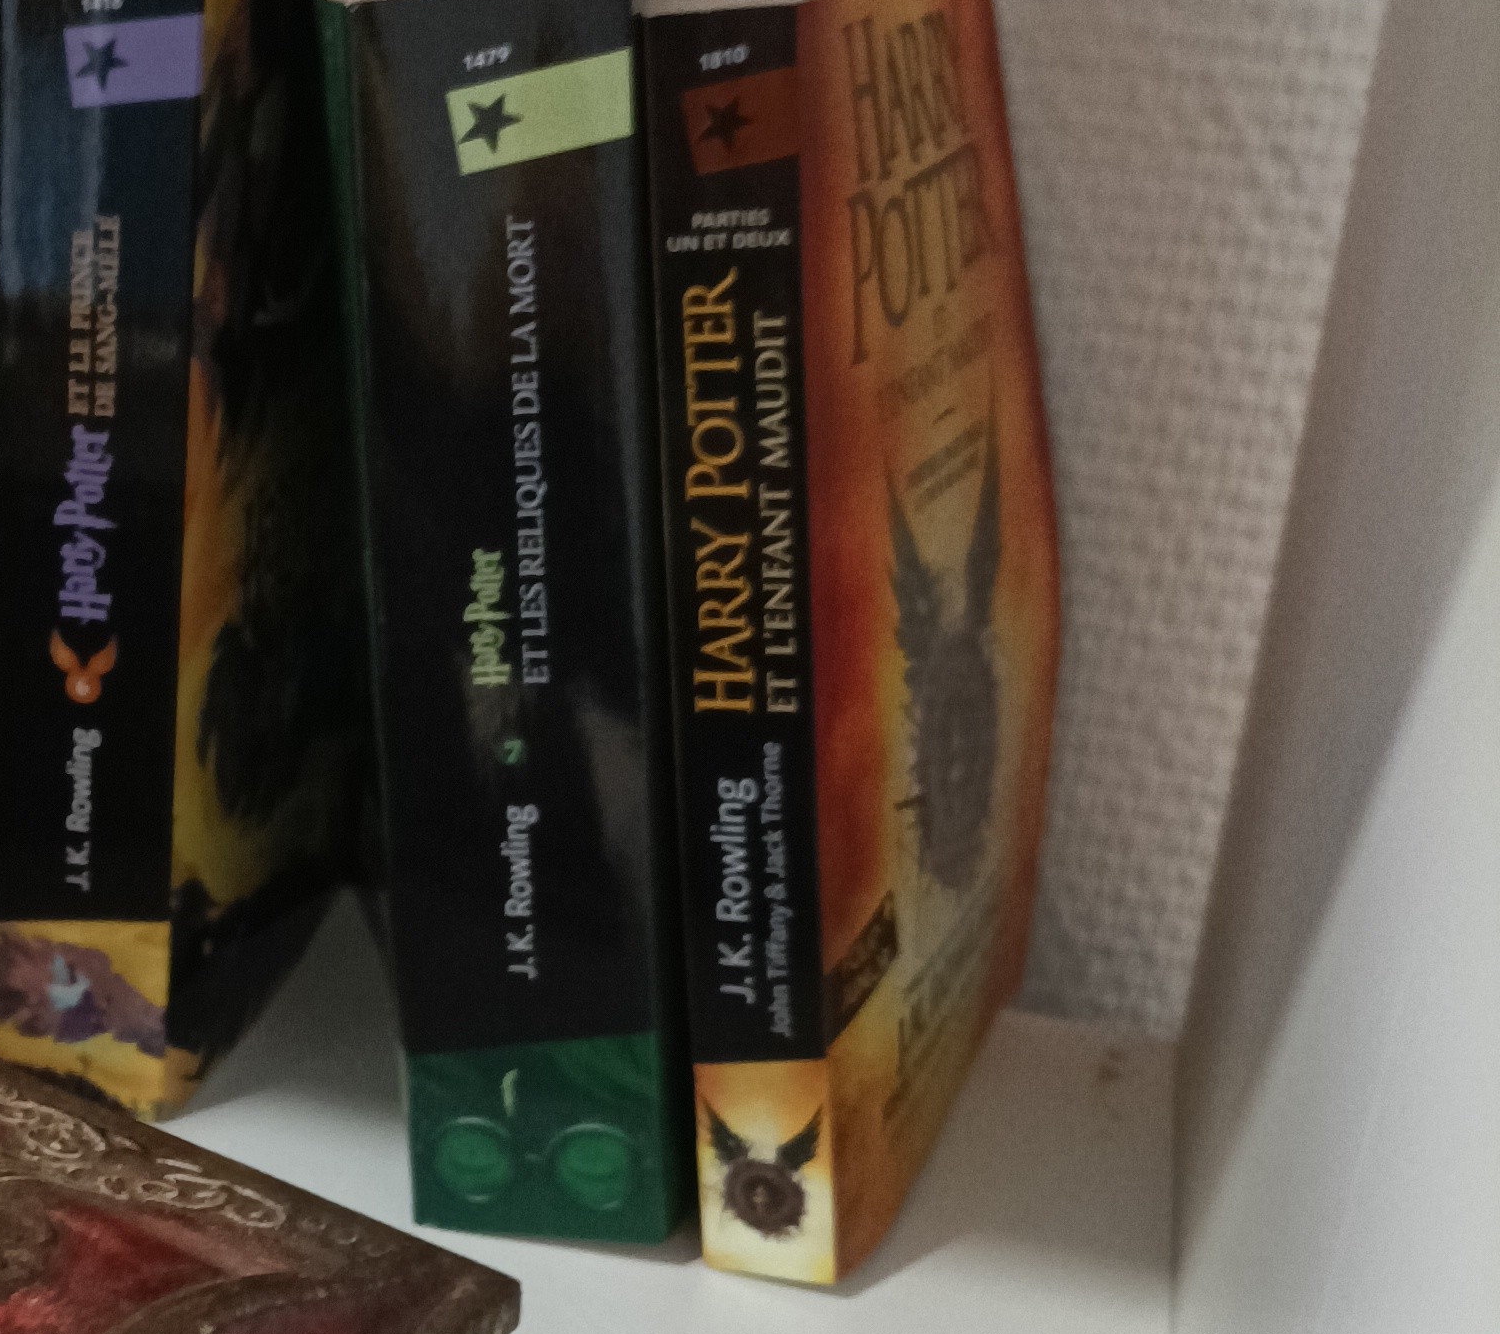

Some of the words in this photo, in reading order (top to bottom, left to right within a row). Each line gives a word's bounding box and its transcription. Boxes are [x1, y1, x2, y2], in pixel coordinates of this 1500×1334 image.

[463, 42, 513, 71] 1479
[699, 43, 751, 72] 1810
[665, 234, 700, 253] UN
[703, 231, 728, 252] ET
[732, 227, 793, 250] DEUX
[690, 207, 772, 230] PARTIES
[68, 227, 96, 331] PRINCE
[505, 213, 538, 316] MORT
[67, 336, 91, 373] LE
[509, 319, 539, 365] LA
[66, 377, 91, 417] ET
[92, 379, 117, 419] DE
[511, 369, 542, 417] DE
[681, 265, 753, 504] POTTER
[752, 309, 790, 469] MAUDIT
[52, 423, 119, 531] Potter
[513, 419, 548, 579] RELIQUES
[56, 527, 114, 626] Harry
[462, 547, 513, 624] Potter
[757, 480, 798, 657] L'ENFANT
[518, 580, 550, 639] LES
[690, 515, 757, 715] HARRY
[469, 624, 514, 688] Harry
[521, 642, 550, 686] ET
[765, 669, 799, 715] ET
[63, 726, 104, 834] Rowling
[760, 740, 782, 825] Thorne
[64, 839, 91, 866] K.
[499, 803, 541, 918] Rowling
[708, 776, 760, 923] Rowling
[760, 828, 787, 879] Jack
[64, 869, 92, 893] J.
[763, 882, 788, 902] &
[504, 922, 535, 952] K.
[717, 932, 753, 967] K.
[764, 902, 795, 980] Tiffany
[505, 955, 539, 981] J.
[719, 975, 757, 1005] J.
[767, 984, 795, 1039] John
